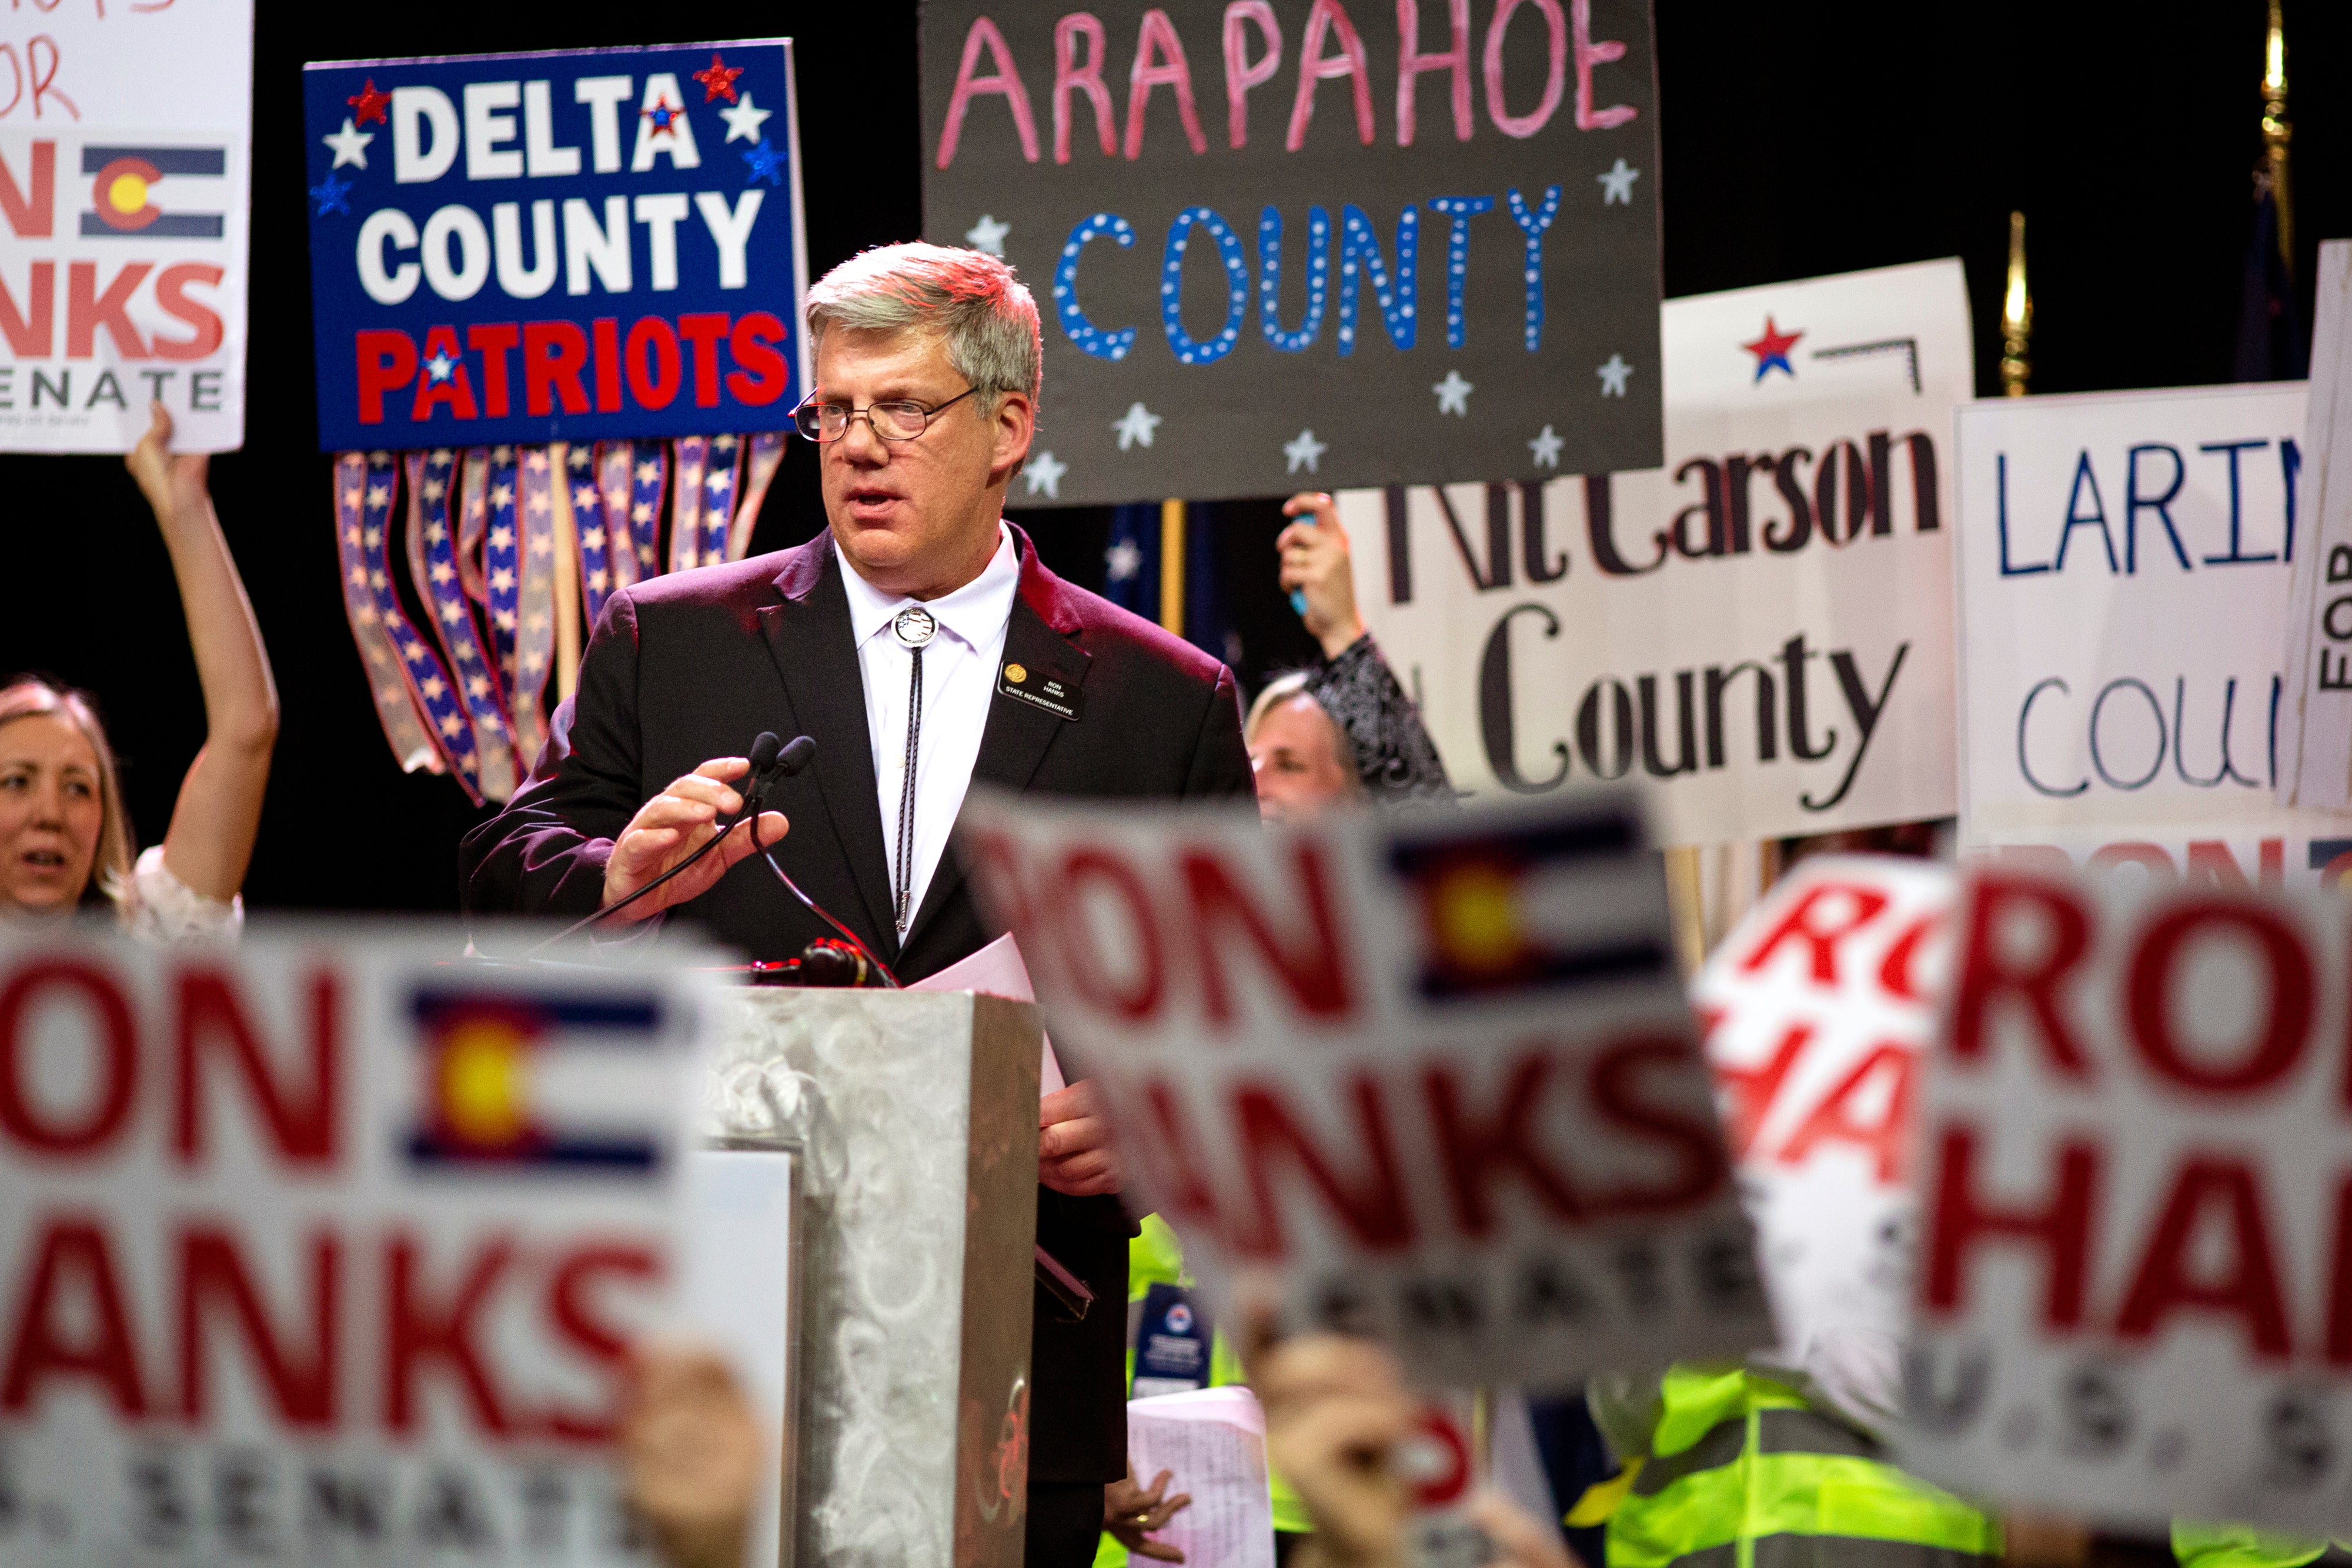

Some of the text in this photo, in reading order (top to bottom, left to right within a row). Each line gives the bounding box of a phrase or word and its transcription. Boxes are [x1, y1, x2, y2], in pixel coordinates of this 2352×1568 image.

[392, 72, 702, 184] DELTA
[936, 0, 1639, 169] ARAPAHOE
[356, 189, 766, 306] COUNTY
[1054, 185, 1562, 365] COUNTY
[356, 312, 789, 425] PATRIOTS
[1005, 686, 1074, 716] STATE REPRESENTATIVE
[1043, 686, 1064, 698] HANKS
[1048, 681, 1062, 691] RON
[1478, 602, 1912, 811] County
[1953, 875, 2352, 1111] RO
[1926, 1126, 2352, 1367] HA
